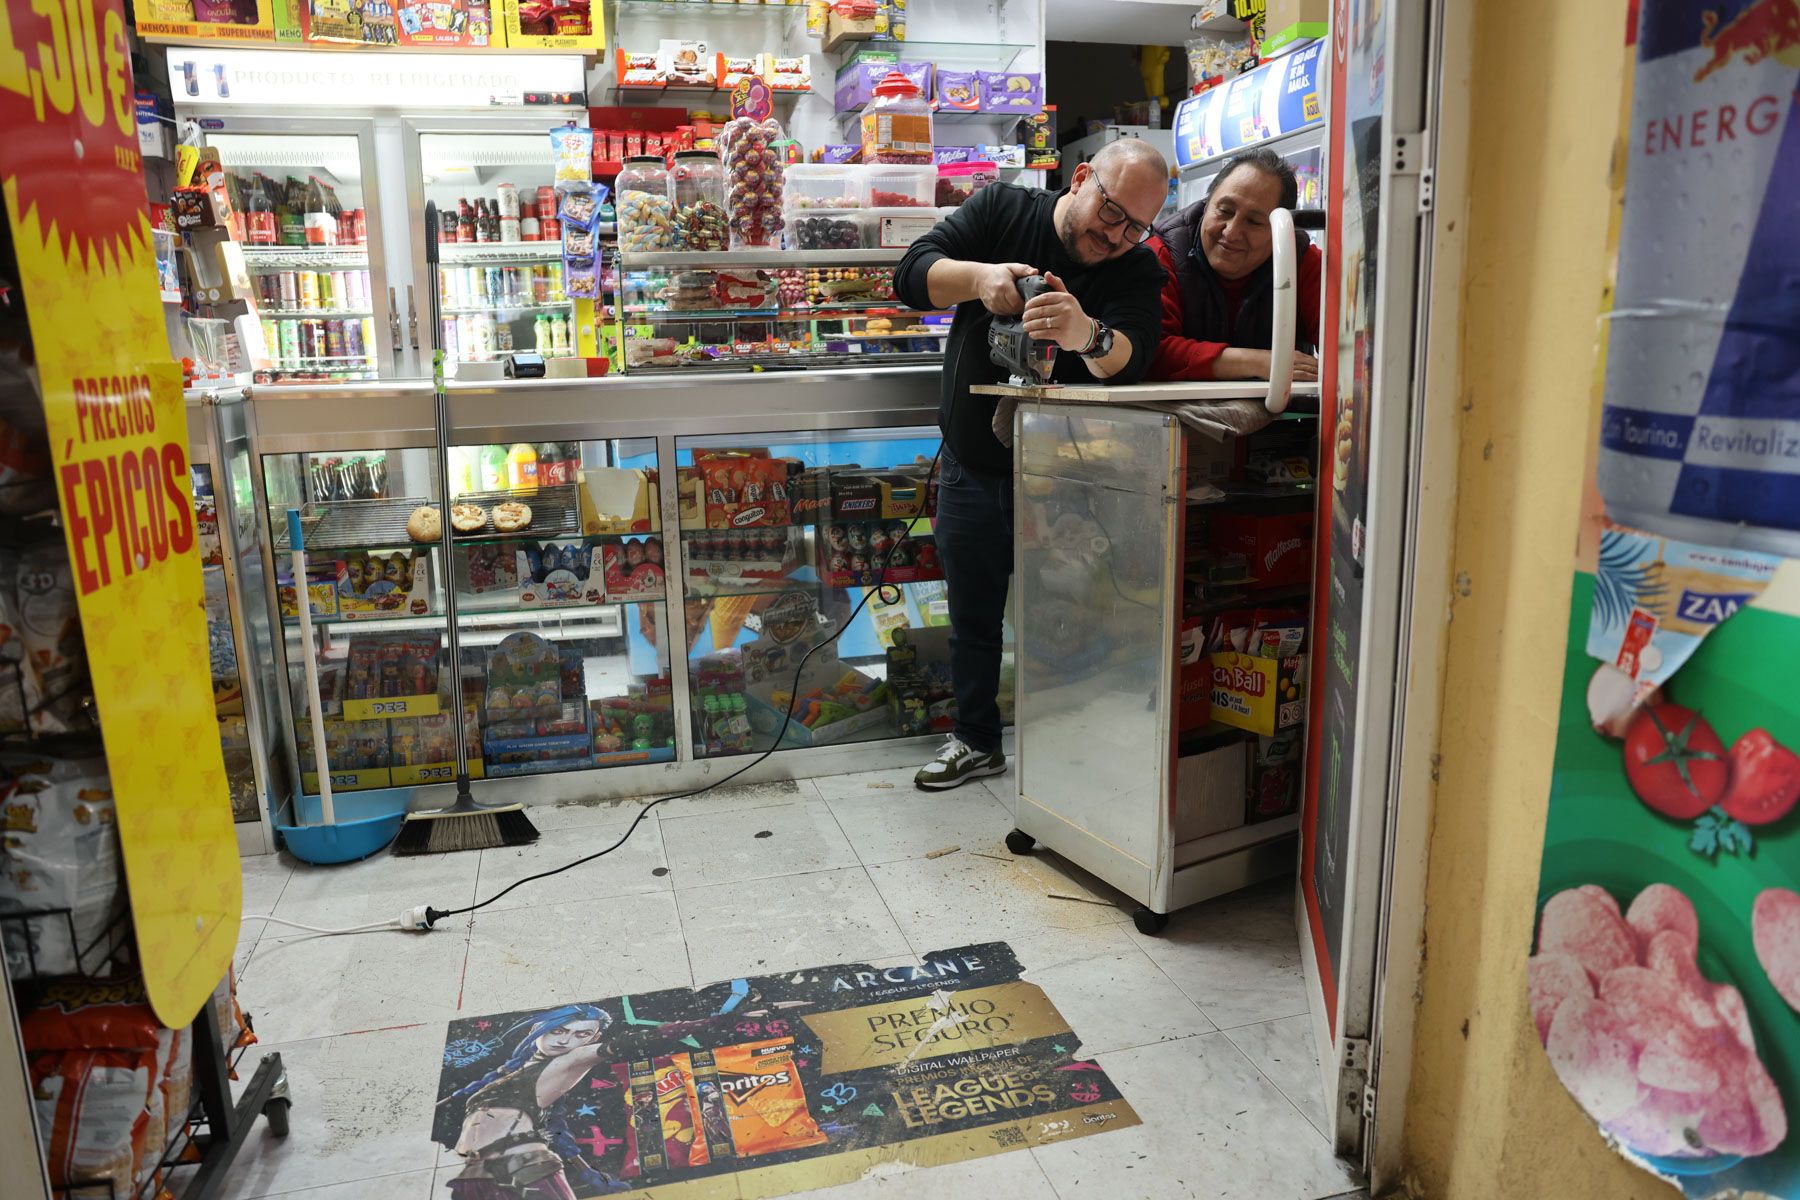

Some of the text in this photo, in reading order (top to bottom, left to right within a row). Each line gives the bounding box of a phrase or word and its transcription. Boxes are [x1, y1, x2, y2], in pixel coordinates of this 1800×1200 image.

[140, 22, 190, 34] MENOS AIRE
[279, 29, 303, 39] MENO
[1645, 90, 1800, 156] ENERG
[831, 145, 853, 158] Milka
[938, 150, 967, 164] Milka
[72, 373, 156, 444] PRECIOS
[1697, 425, 1800, 459] Revitaliz
[60, 437, 194, 597] ÉPICOS
[734, 508, 764, 524] conguitos
[842, 499, 876, 511] SNICKERS
[1263, 538, 1302, 572] Maltesers
[1233, 667, 1262, 693] Ball
[372, 701, 407, 714] PEZ
[419, 767, 453, 780] PEZ
[831, 954, 986, 993] ARCANE
[914, 977, 961, 990] LEGENDS
[866, 998, 996, 1033] PREMIO
[896, 1047, 1021, 1076] DIGITAL WALLPAPER
[721, 1071, 790, 1093] oritos
[891, 1070, 1042, 1110] LEAGUE OF
[899, 1083, 1057, 1129] LEGENDS
